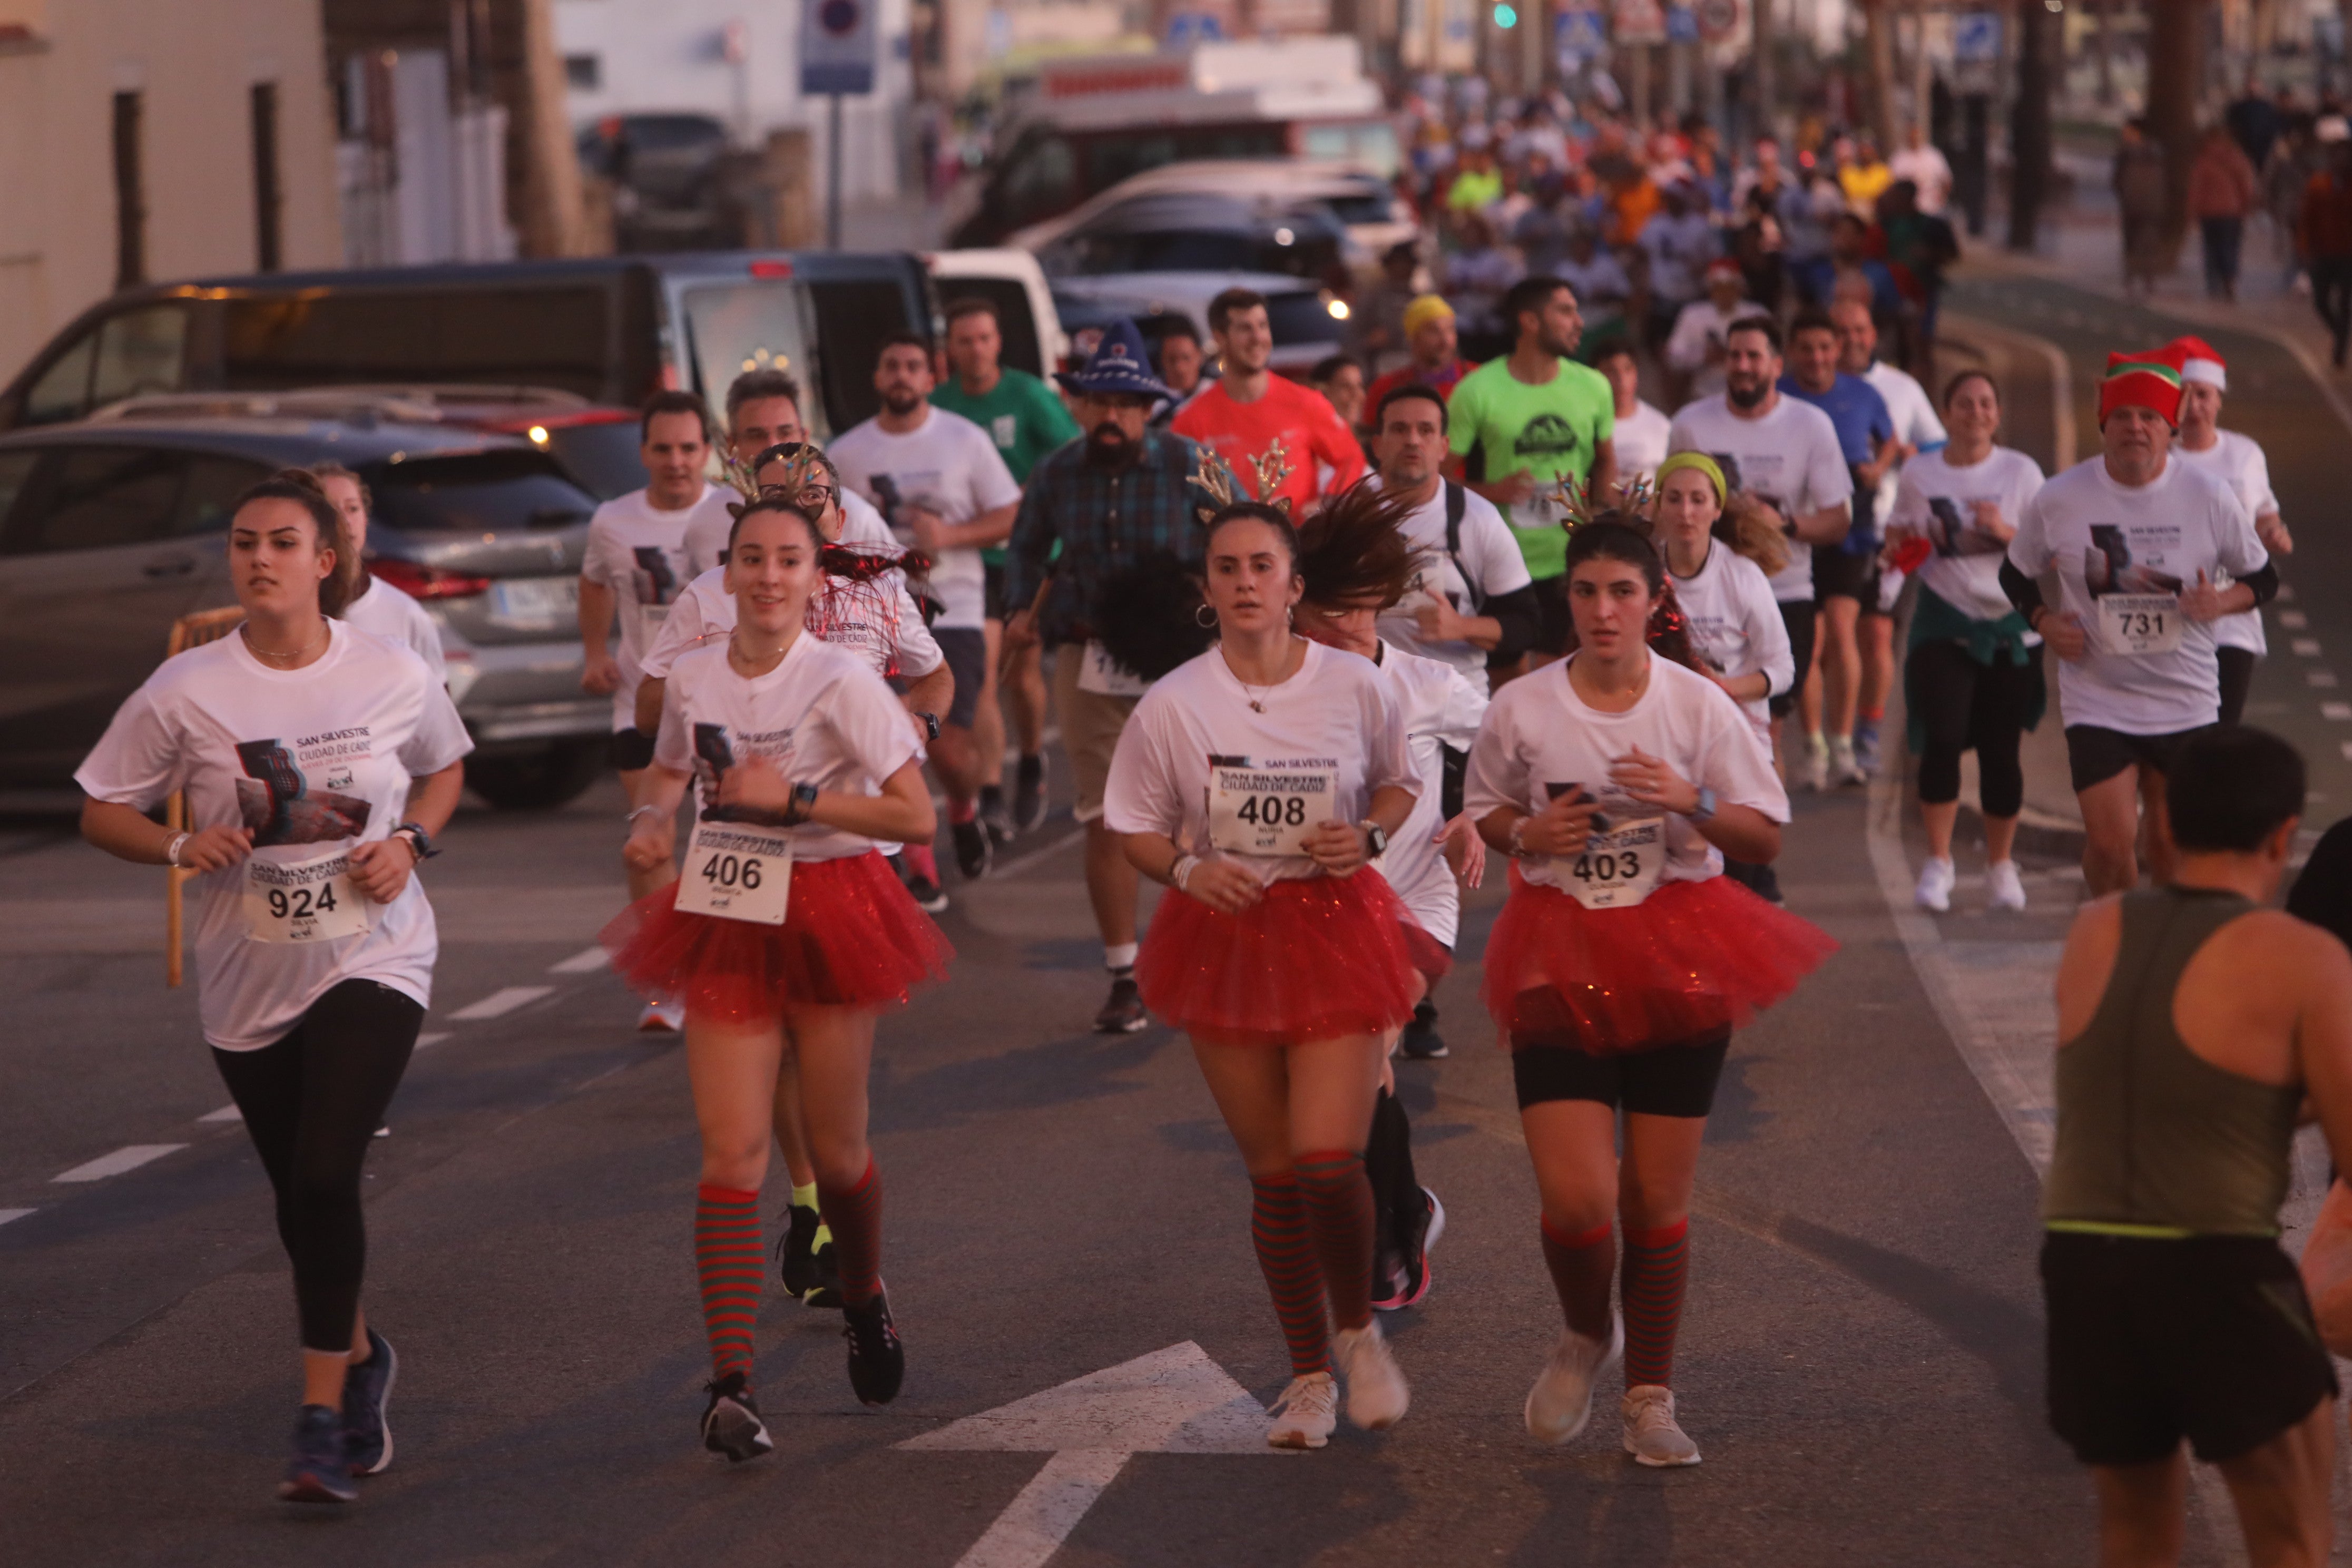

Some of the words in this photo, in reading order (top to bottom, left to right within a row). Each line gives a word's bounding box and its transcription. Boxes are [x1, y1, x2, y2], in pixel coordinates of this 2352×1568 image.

[826, 622, 867, 632] SILVESTRE
[2119, 613, 2163, 635] 731
[837, 634, 846, 643] DE
[296, 734, 319, 748] SAN
[320, 726, 370, 743] SILVESTRE
[299, 746, 335, 762] CIUDAD
[337, 743, 348, 755] DE
[1265, 760, 1286, 768] SAN
[1238, 795, 1305, 826] 408
[701, 852, 763, 890] 406
[1572, 850, 1641, 883] 403
[268, 881, 337, 918] 924
